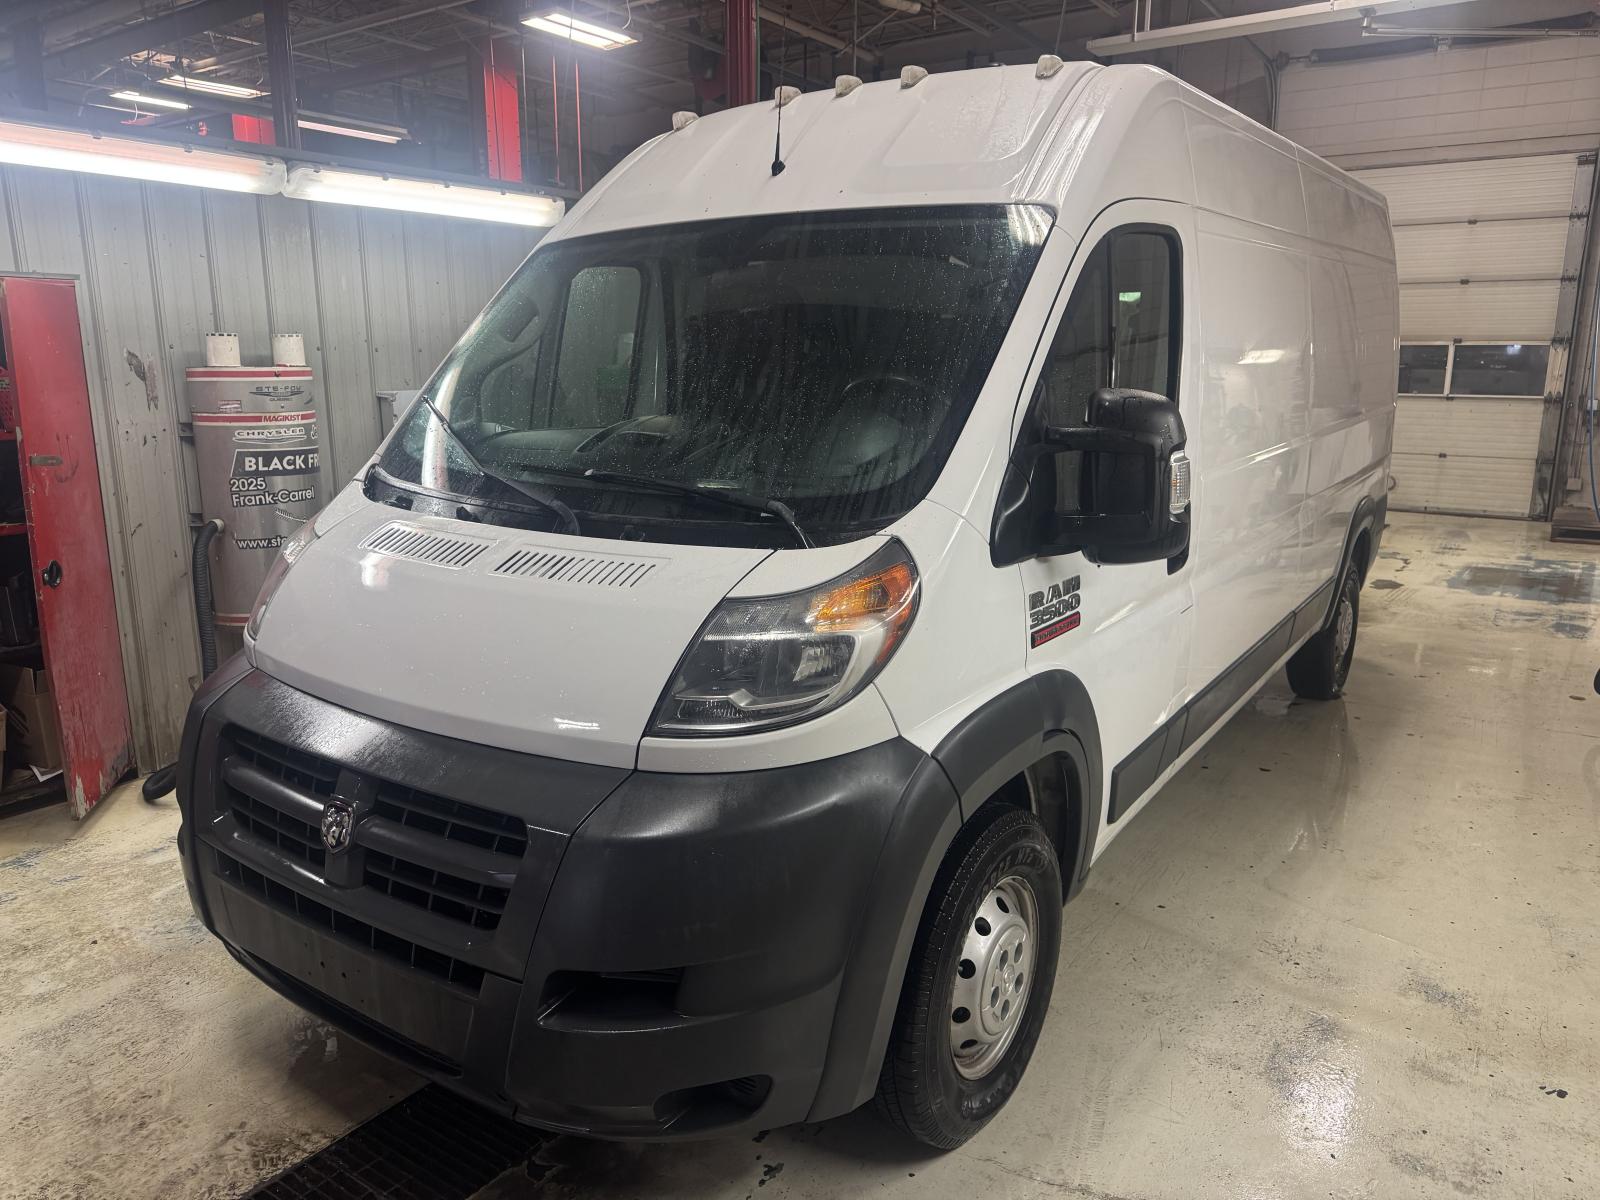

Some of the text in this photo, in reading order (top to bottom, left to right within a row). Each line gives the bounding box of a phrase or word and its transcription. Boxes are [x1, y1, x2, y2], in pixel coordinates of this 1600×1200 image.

[263, 414, 301, 422] MAGIKIST
[236, 427, 304, 438] CHRYSLER
[244, 454, 305, 471] BLACK
[230, 478, 266, 491] 2025
[232, 486, 315, 507] Frank-Carrel
[1029, 575, 1080, 611] RAM
[1030, 593, 1080, 630] 3500
